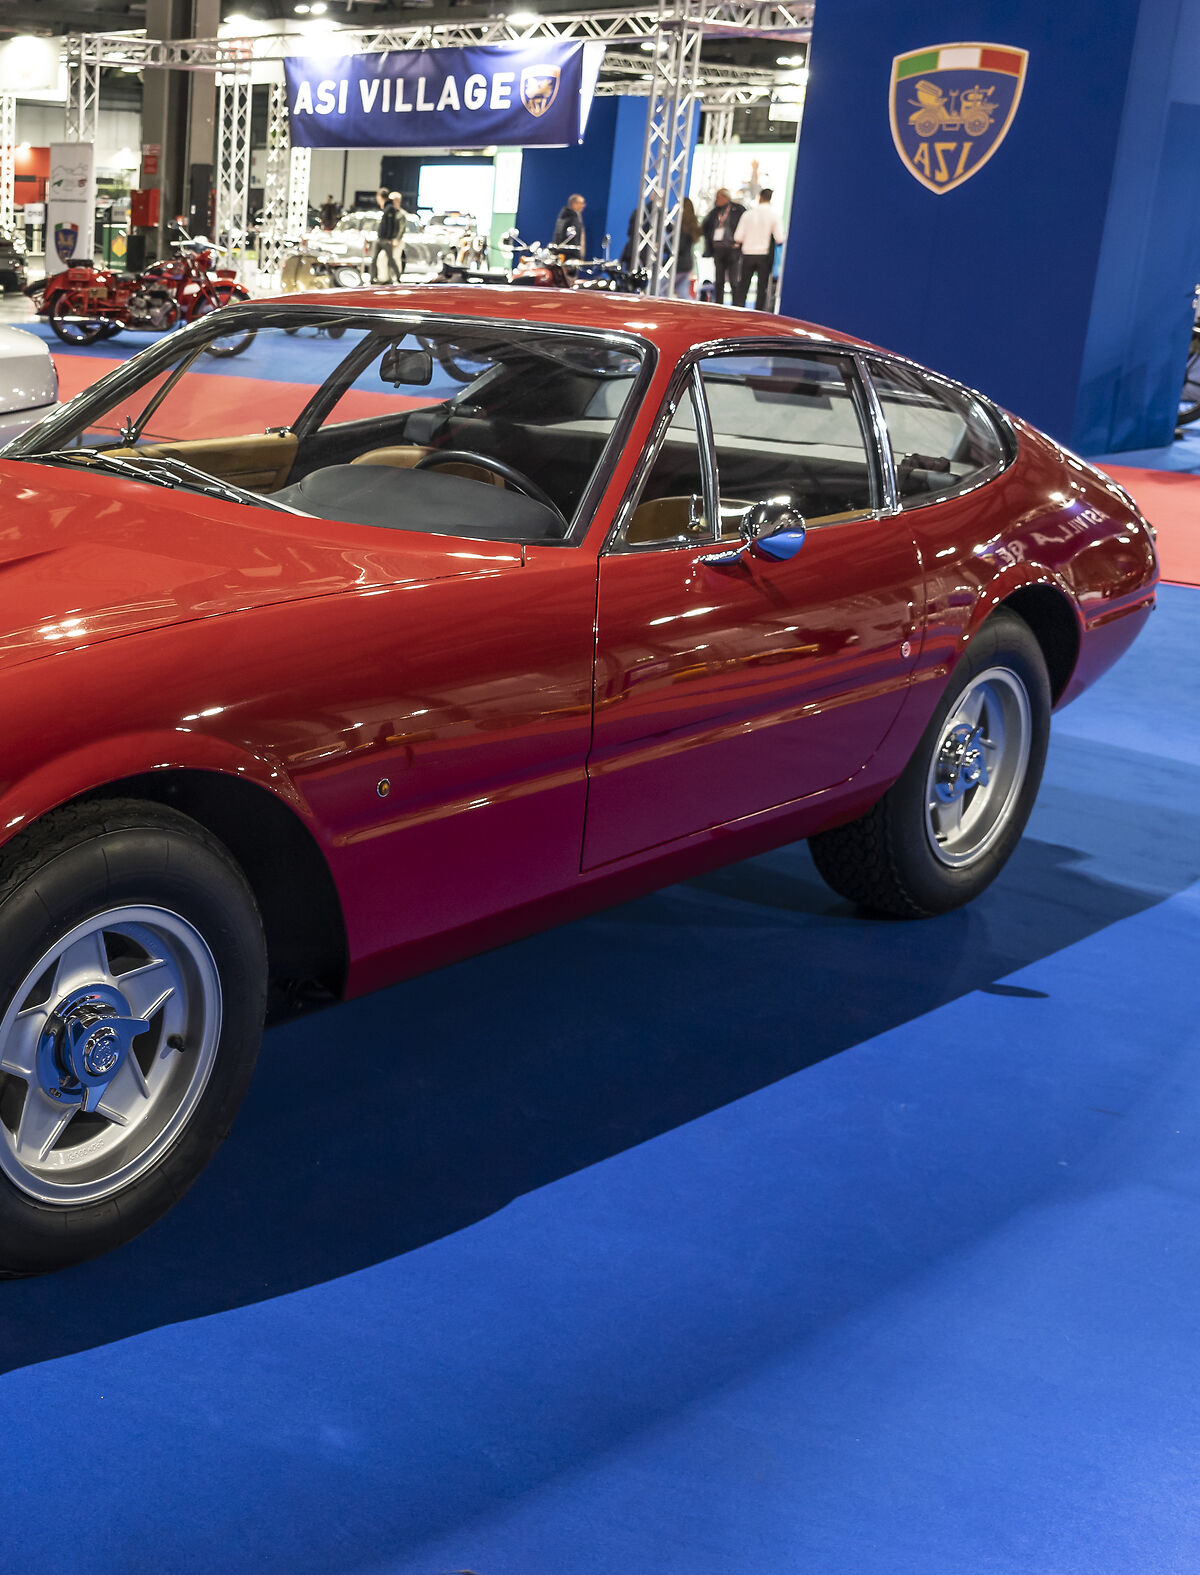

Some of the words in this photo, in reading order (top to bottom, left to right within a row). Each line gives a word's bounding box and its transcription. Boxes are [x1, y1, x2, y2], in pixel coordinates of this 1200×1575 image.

[293, 80, 348, 115] ASI
[359, 72, 515, 113] VILLAGE
[913, 141, 973, 182] ASI
